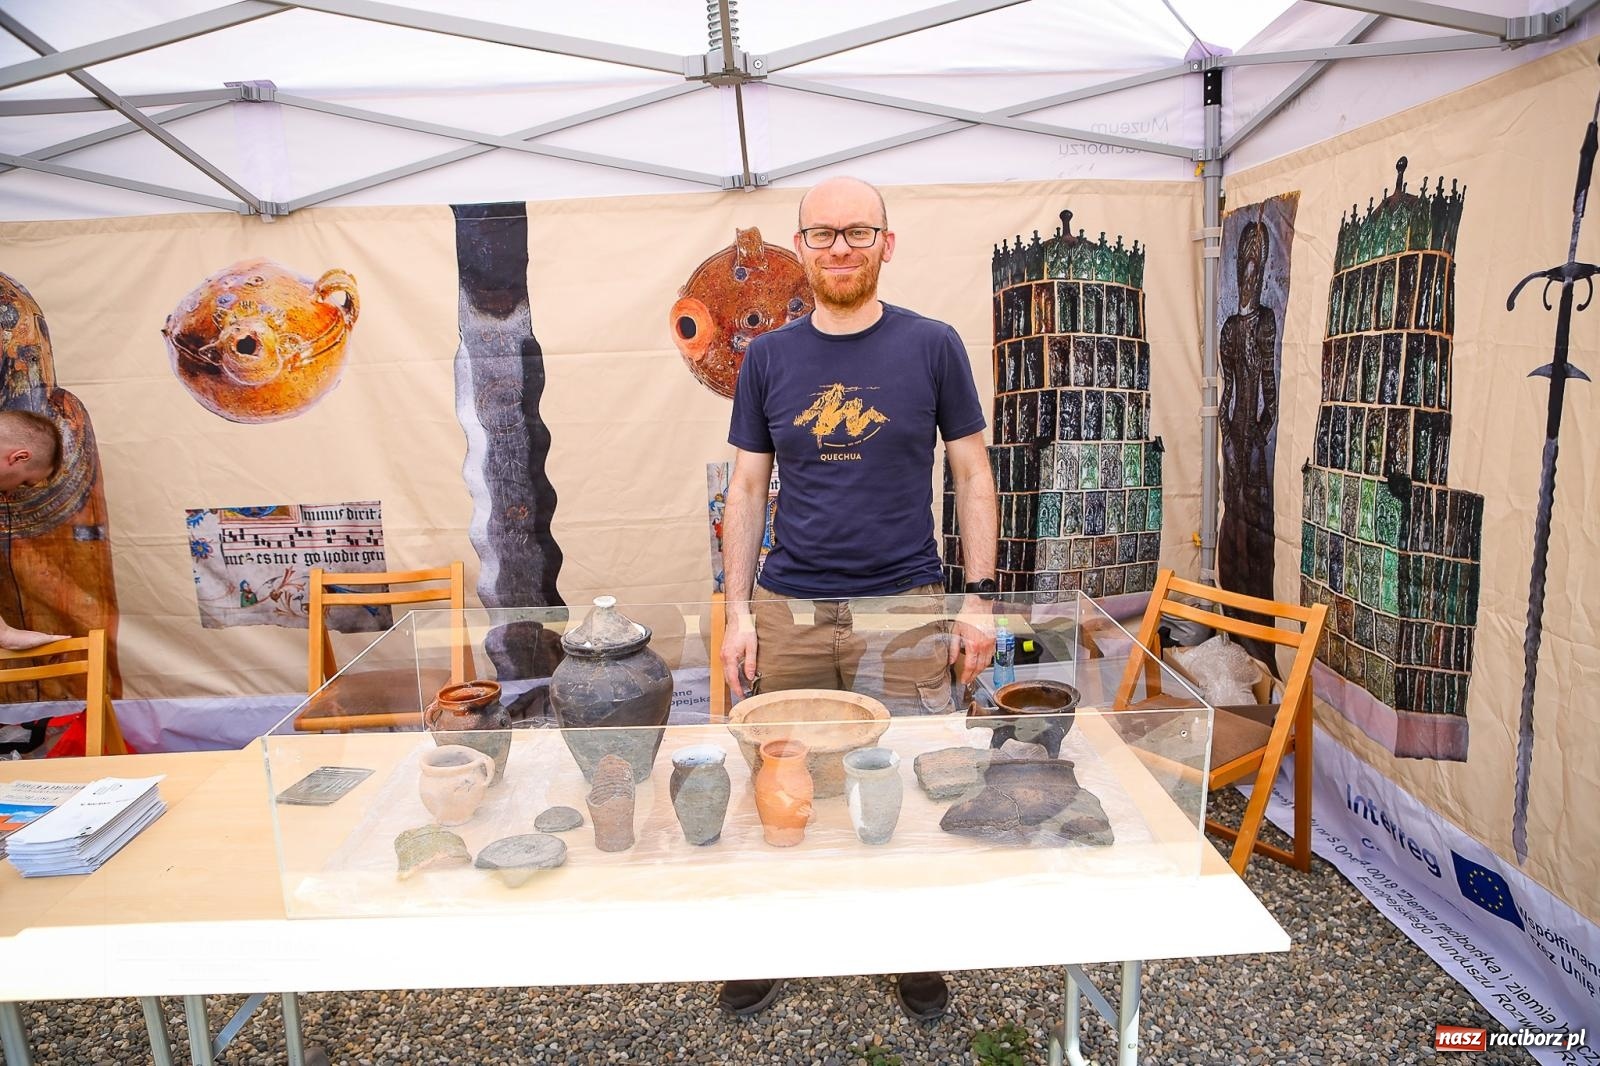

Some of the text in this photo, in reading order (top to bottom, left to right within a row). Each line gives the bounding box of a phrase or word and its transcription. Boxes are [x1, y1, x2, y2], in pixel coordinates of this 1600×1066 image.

[820, 453, 861, 461] QUECHUA
[1346, 783, 1442, 879] Interreg
[1357, 876, 1434, 935] Europejskiego
[1431, 935, 1496, 989] Funduszu
[1435, 922, 1502, 974] raciborska
[1505, 981, 1556, 1024] ziemia
